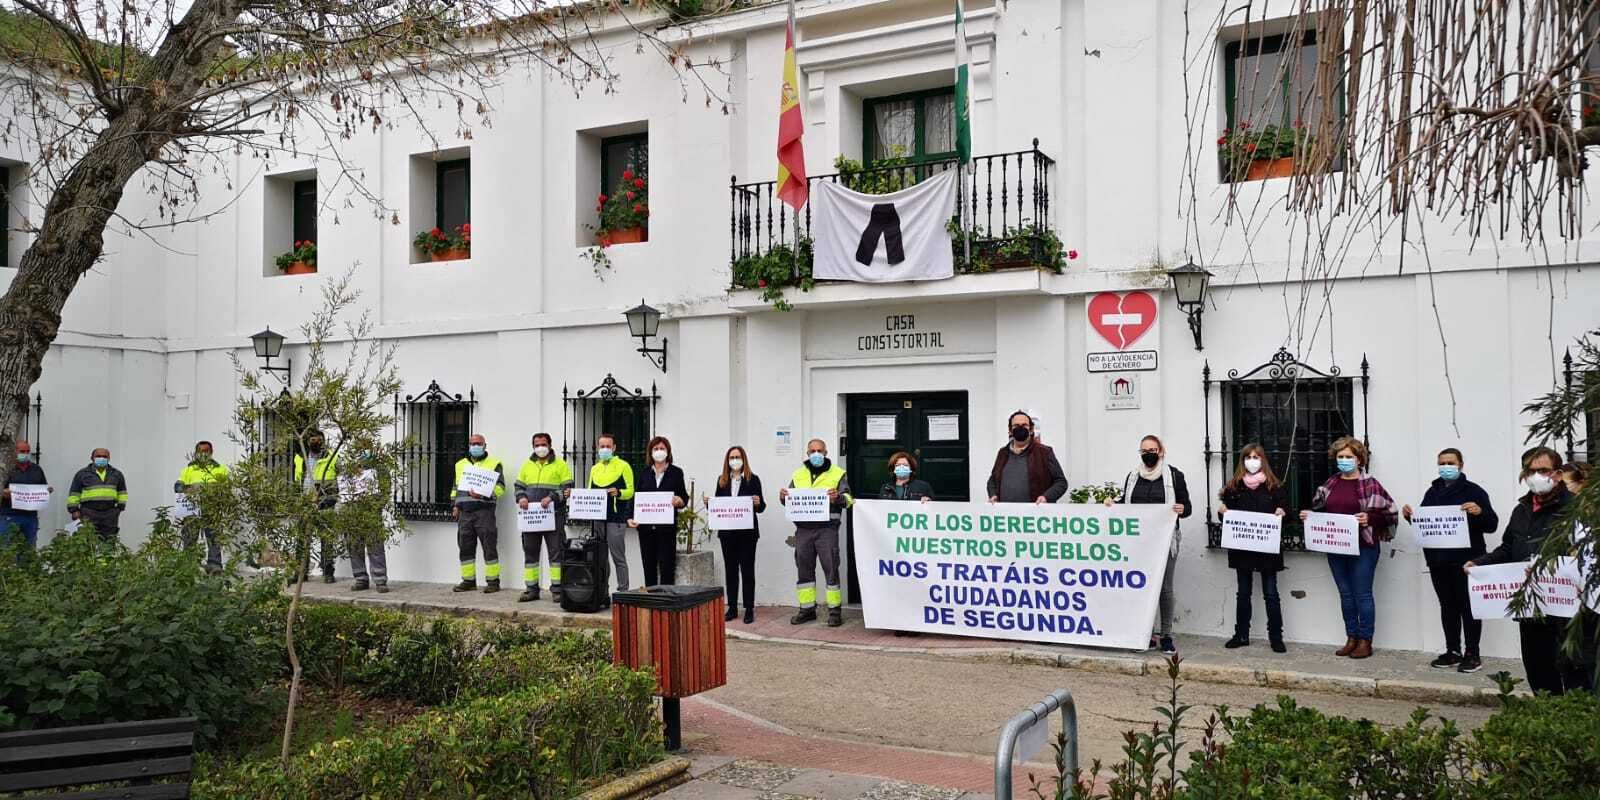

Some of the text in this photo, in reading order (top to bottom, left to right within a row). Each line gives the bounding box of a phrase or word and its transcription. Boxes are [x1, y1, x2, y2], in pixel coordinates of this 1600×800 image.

[885, 314, 915, 331] CASA
[857, 332, 944, 351] CONSISTORIAL
[1117, 353, 1154, 361] VIOLENCIA
[886, 512, 1140, 536] POR LOS DERECHOS DE
[1232, 526, 1255, 534] VECINOS
[1260, 522, 1279, 530] SOMOS
[895, 536, 1129, 562] NUESTROS PUEBLOS.
[1324, 539, 1351, 548] SERVICIOS
[878, 559, 1147, 589] NOS TRATÁIS COMO
[1472, 583, 1497, 592] CONTRA
[1499, 582, 1507, 590] EL
[1548, 586, 1556, 594] NO
[929, 584, 1087, 612] CIUDADANOS
[1546, 596, 1575, 606] SERVICIOS
[924, 605, 1103, 636] DE SEGUNDA.
